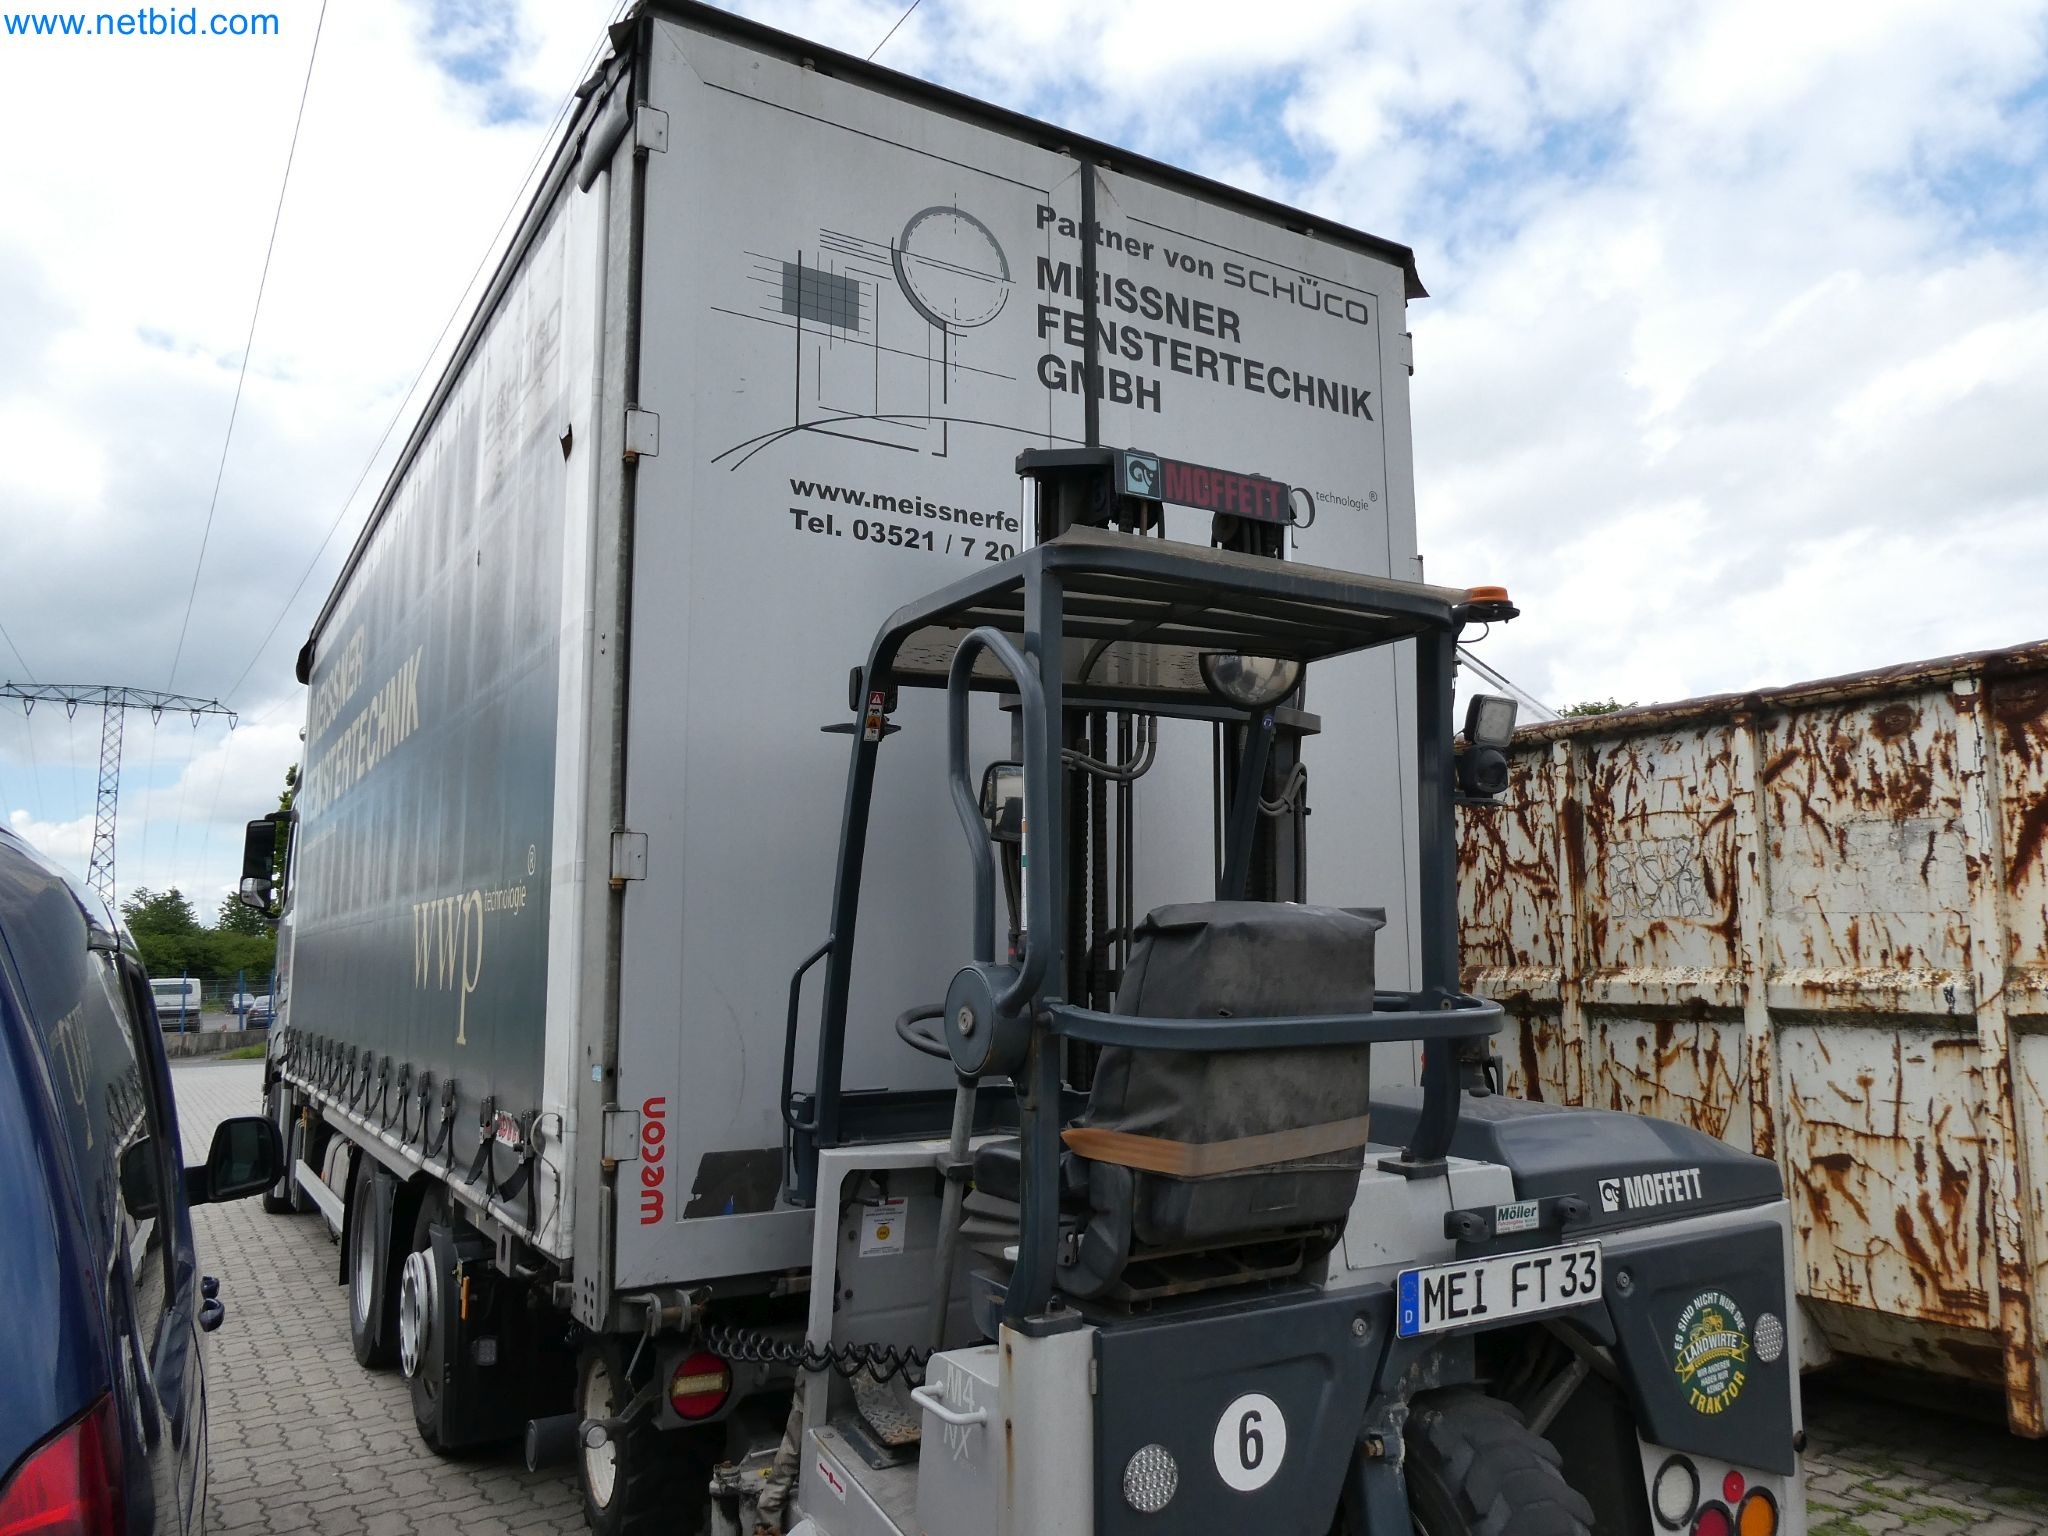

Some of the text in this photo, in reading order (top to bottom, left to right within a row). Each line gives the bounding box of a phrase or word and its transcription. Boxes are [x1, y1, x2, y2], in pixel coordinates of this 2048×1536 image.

[1163, 248, 1214, 279] von
[1223, 261, 1368, 325] SCHÜCO
[1037, 304, 1374, 421] FENSTERTECHNIK
[1037, 353, 1161, 413] GMBH
[789, 478, 1019, 532] www.meissnerfe
[1165, 463, 1281, 518] MOFFETT
[789, 507, 1015, 562] Tel. 03521 / 7 20
[413, 890, 484, 1046] wwp
[640, 1097, 667, 1224] wecon
[1623, 1168, 1702, 1208] MOFFETT
[1498, 1205, 1536, 1221] Möller
[1405, 1250, 1596, 1324] D MEI FT 33
[1674, 1292, 1746, 1350] ES SIND NICHT NUR DIE
[1684, 1333, 1737, 1363] LANDWIRTE
[1689, 1371, 1745, 1414] TRAKTOR
[1239, 1410, 1263, 1470] 6
